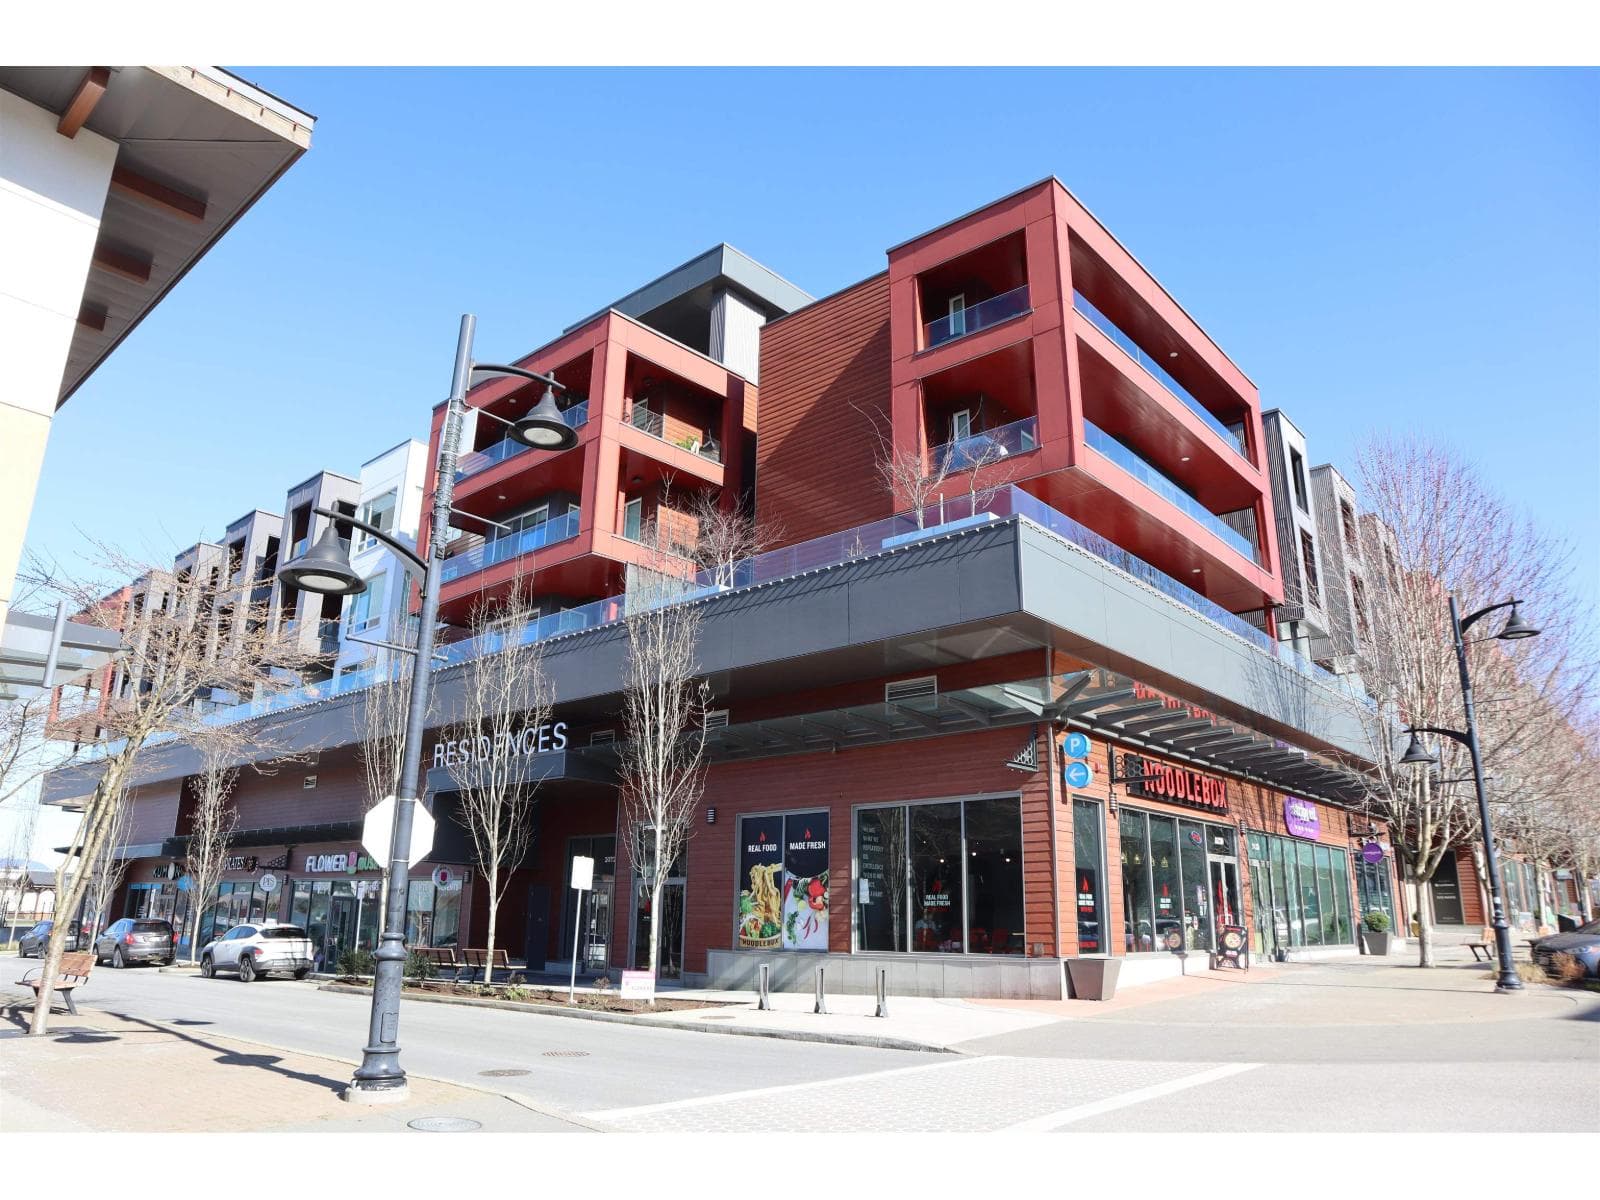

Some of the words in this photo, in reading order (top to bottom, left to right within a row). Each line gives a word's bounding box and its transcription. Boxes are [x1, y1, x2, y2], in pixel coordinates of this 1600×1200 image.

[433, 722, 568, 768] RESIDENCES
[1070, 738, 1081, 753] P
[1143, 759, 1228, 808] NOODLEBOX
[763, 843, 777, 852] FOOD
[789, 842, 805, 850] MADE
[806, 841, 826, 849] FRESH
[305, 854, 347, 873] FLOWER
